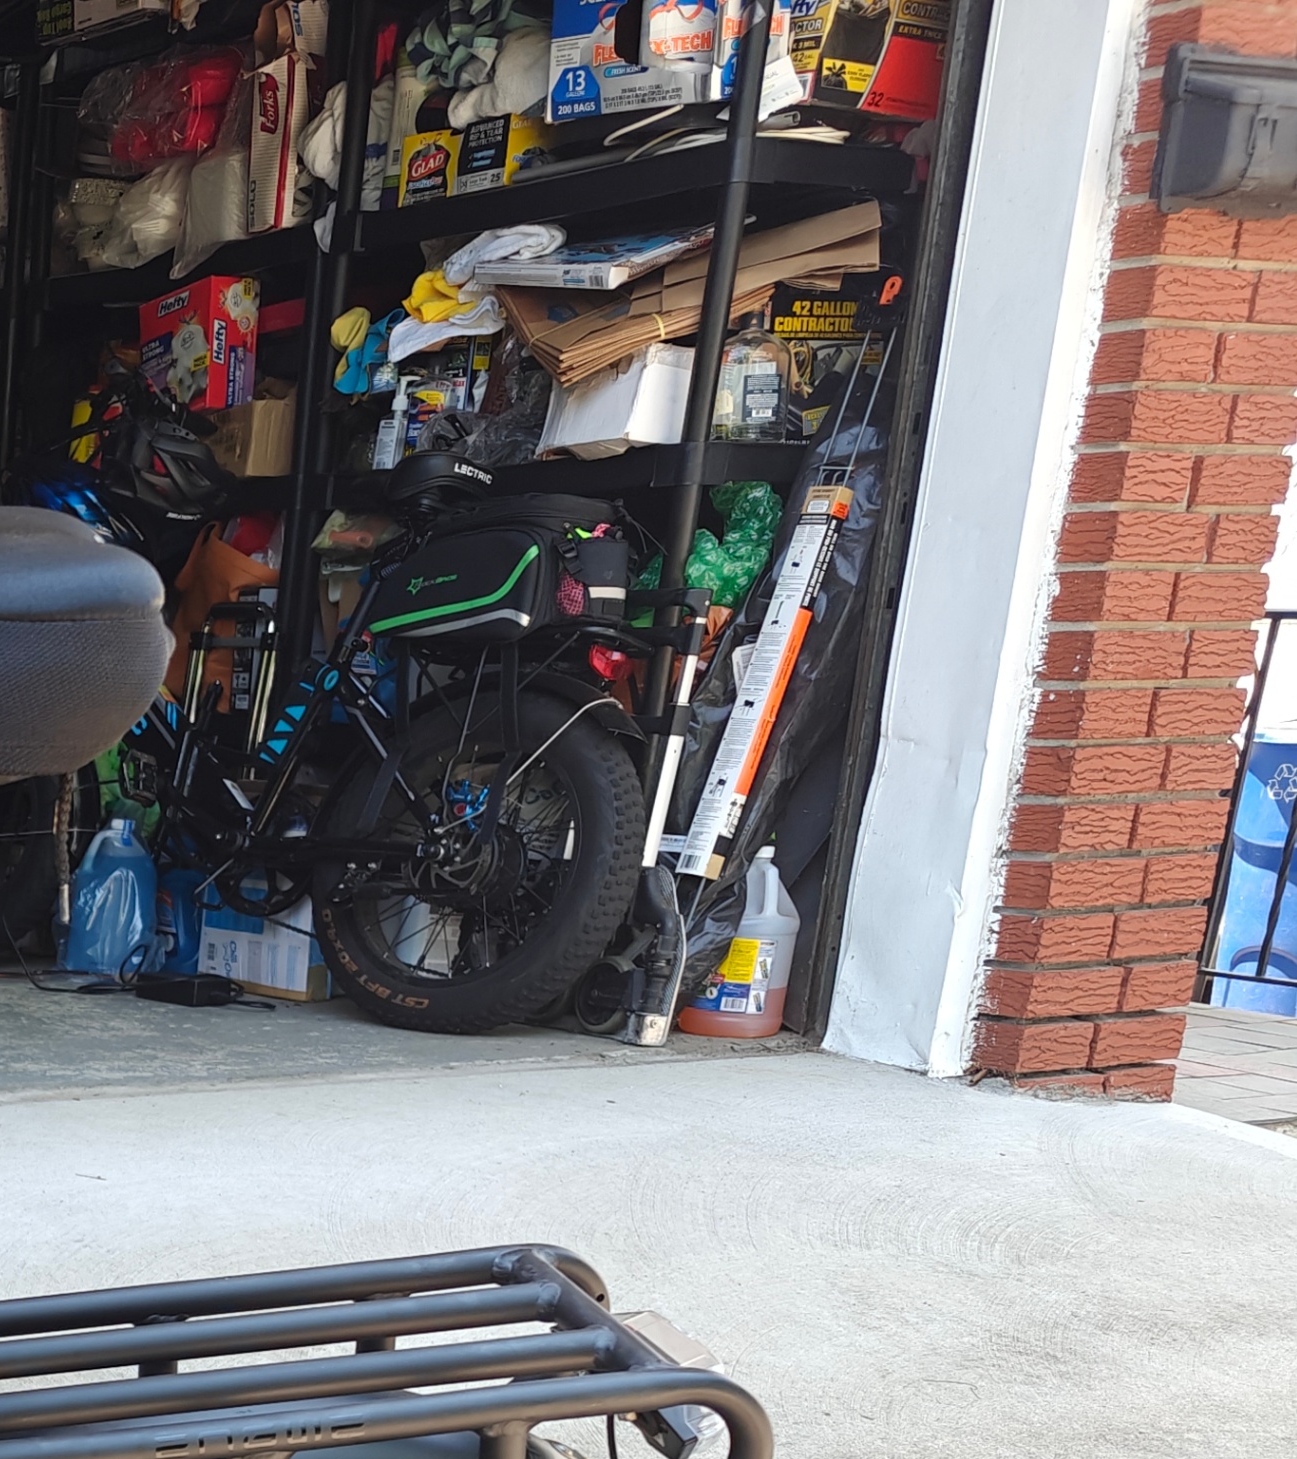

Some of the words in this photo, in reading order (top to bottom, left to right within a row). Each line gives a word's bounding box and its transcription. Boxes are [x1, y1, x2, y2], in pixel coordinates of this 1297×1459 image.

[565, 70, 587, 92] 13
[263, 89, 276, 130] Forks
[558, 104, 571, 115] 200
[572, 101, 596, 113] BAGS
[867, 91, 885, 108] 32
[411, 153, 445, 178] GLAD
[489, 172, 501, 183] 25
[159, 293, 189, 315] Hefty
[792, 300, 811, 316] 42
[774, 316, 855, 332] CONTRACTO
[213, 322, 227, 362] Hefty
[454, 462, 494, 485] LECTRIC
[391, 992, 430, 1009] CST
[154, 1414, 365, 1459] ENGWE
